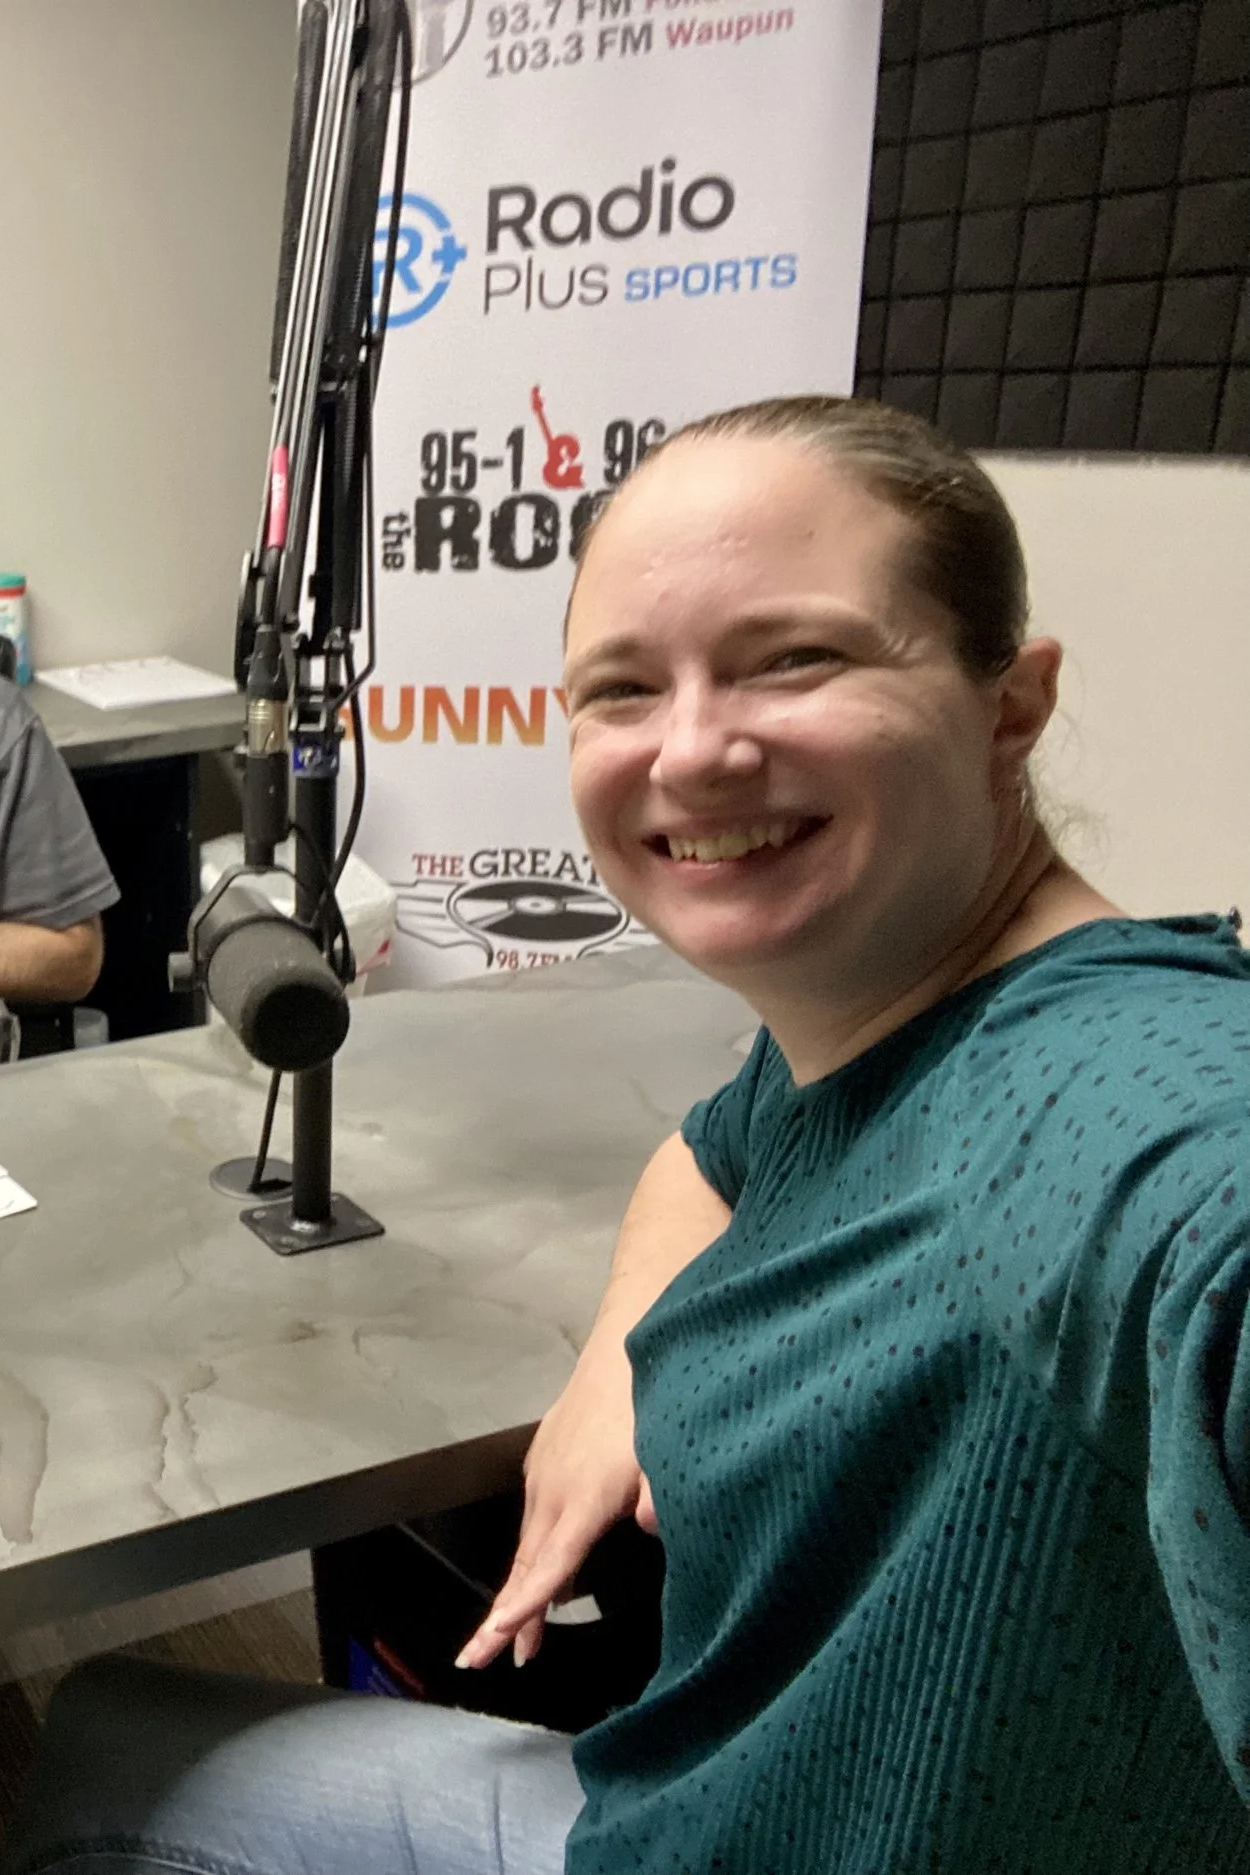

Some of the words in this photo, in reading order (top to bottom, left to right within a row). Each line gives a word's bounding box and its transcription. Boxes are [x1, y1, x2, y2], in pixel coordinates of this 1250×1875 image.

[485, 32, 584, 79] 103.3
[596, 24, 653, 61] FM
[666, 11, 795, 49] Waupun
[487, 0, 561, 39] 93.7
[576, 0, 633, 24] FM
[485, 157, 736, 254] Radio
[483, 257, 609, 316] Plus
[624, 253, 798, 303] SPORTS
[419, 425, 526, 495] 95-1
[382, 512, 411, 571] the
[338, 684, 568, 746] UNN
[411, 853, 464, 878] THE
